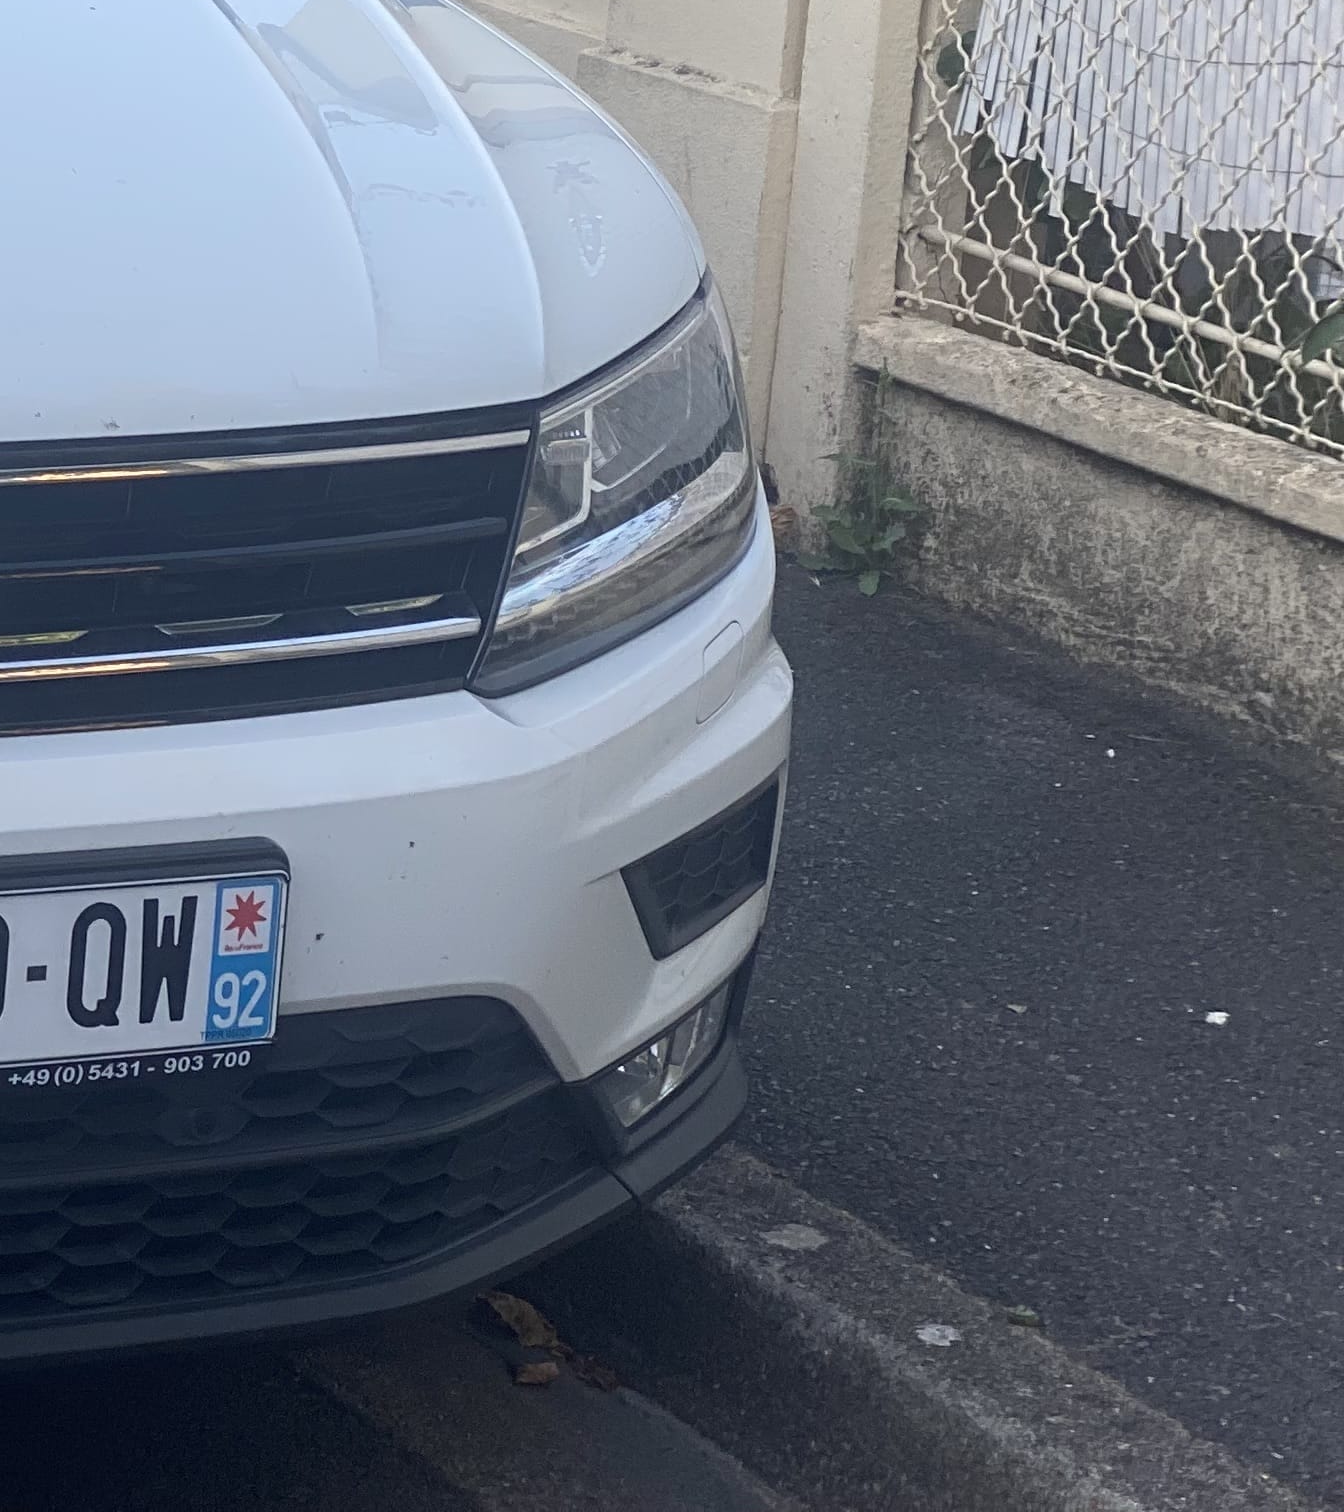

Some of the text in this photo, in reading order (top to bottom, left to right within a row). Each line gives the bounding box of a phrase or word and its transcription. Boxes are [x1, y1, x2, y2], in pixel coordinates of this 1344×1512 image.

[212, 969, 267, 1029] 92
[163, 1054, 204, 1074] 903
[211, 1050, 251, 1070] 700
